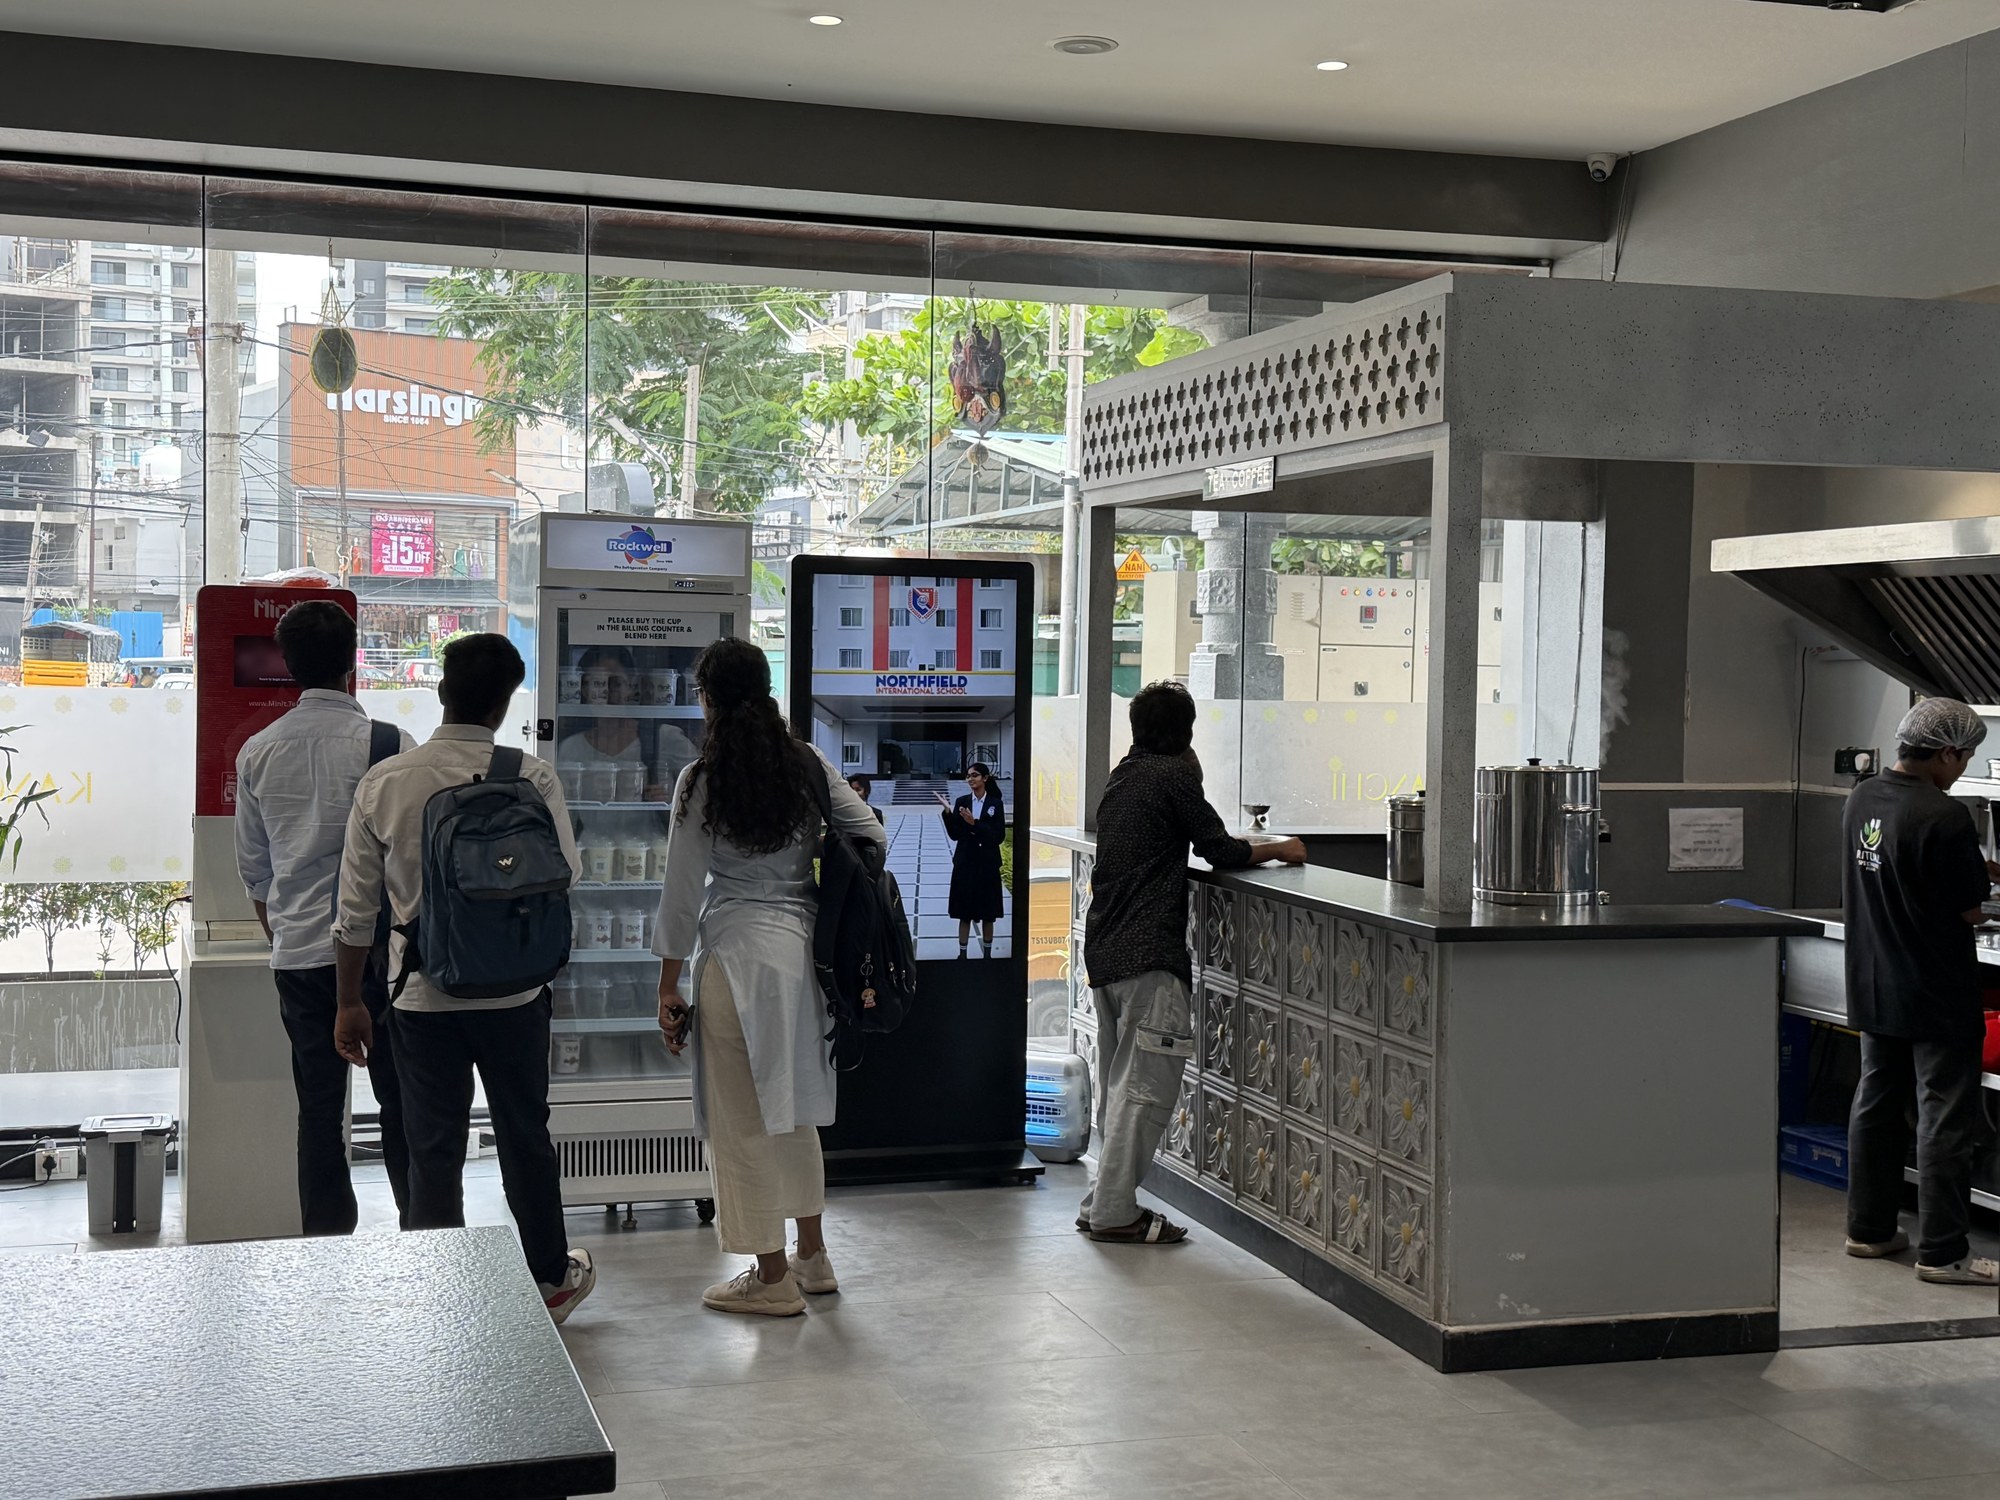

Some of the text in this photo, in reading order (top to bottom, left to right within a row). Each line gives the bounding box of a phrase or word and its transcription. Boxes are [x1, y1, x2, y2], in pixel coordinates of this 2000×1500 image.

[383, 414, 409, 425] SINCE
[1207, 465, 1271, 493] TEA COFFEE
[609, 540, 667, 552] Rockwell
[382, 543, 391, 563] FLAT
[414, 551, 431, 564] OFF
[254, 599, 298, 618] Min
[651, 625, 684, 633] COUNTER
[876, 675, 968, 687] NORTHFIELD
[876, 687, 967, 695] INTERNATIONAL SCHOOL
